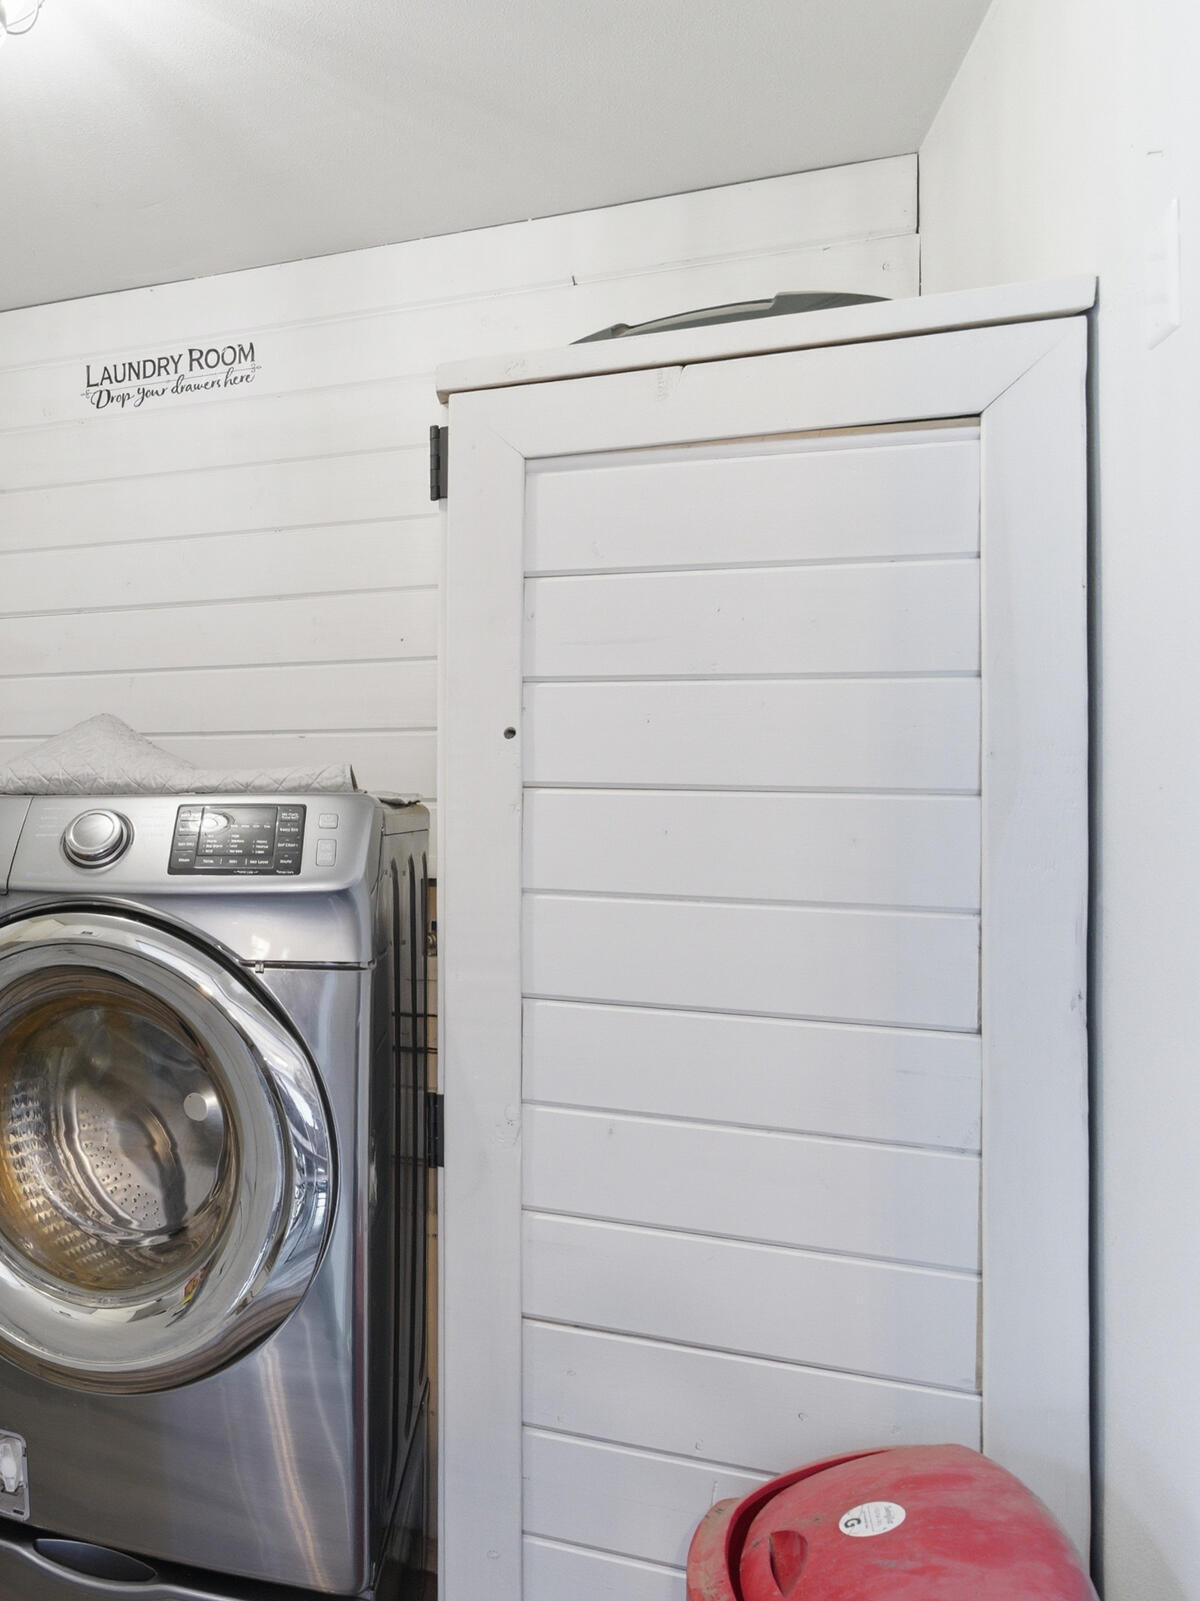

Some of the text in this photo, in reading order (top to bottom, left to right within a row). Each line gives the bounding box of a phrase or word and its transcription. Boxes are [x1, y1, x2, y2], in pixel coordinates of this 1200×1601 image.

[85, 342, 256, 388] LAUNDRY ROOM
[91, 367, 256, 409] Drop your drawers here
